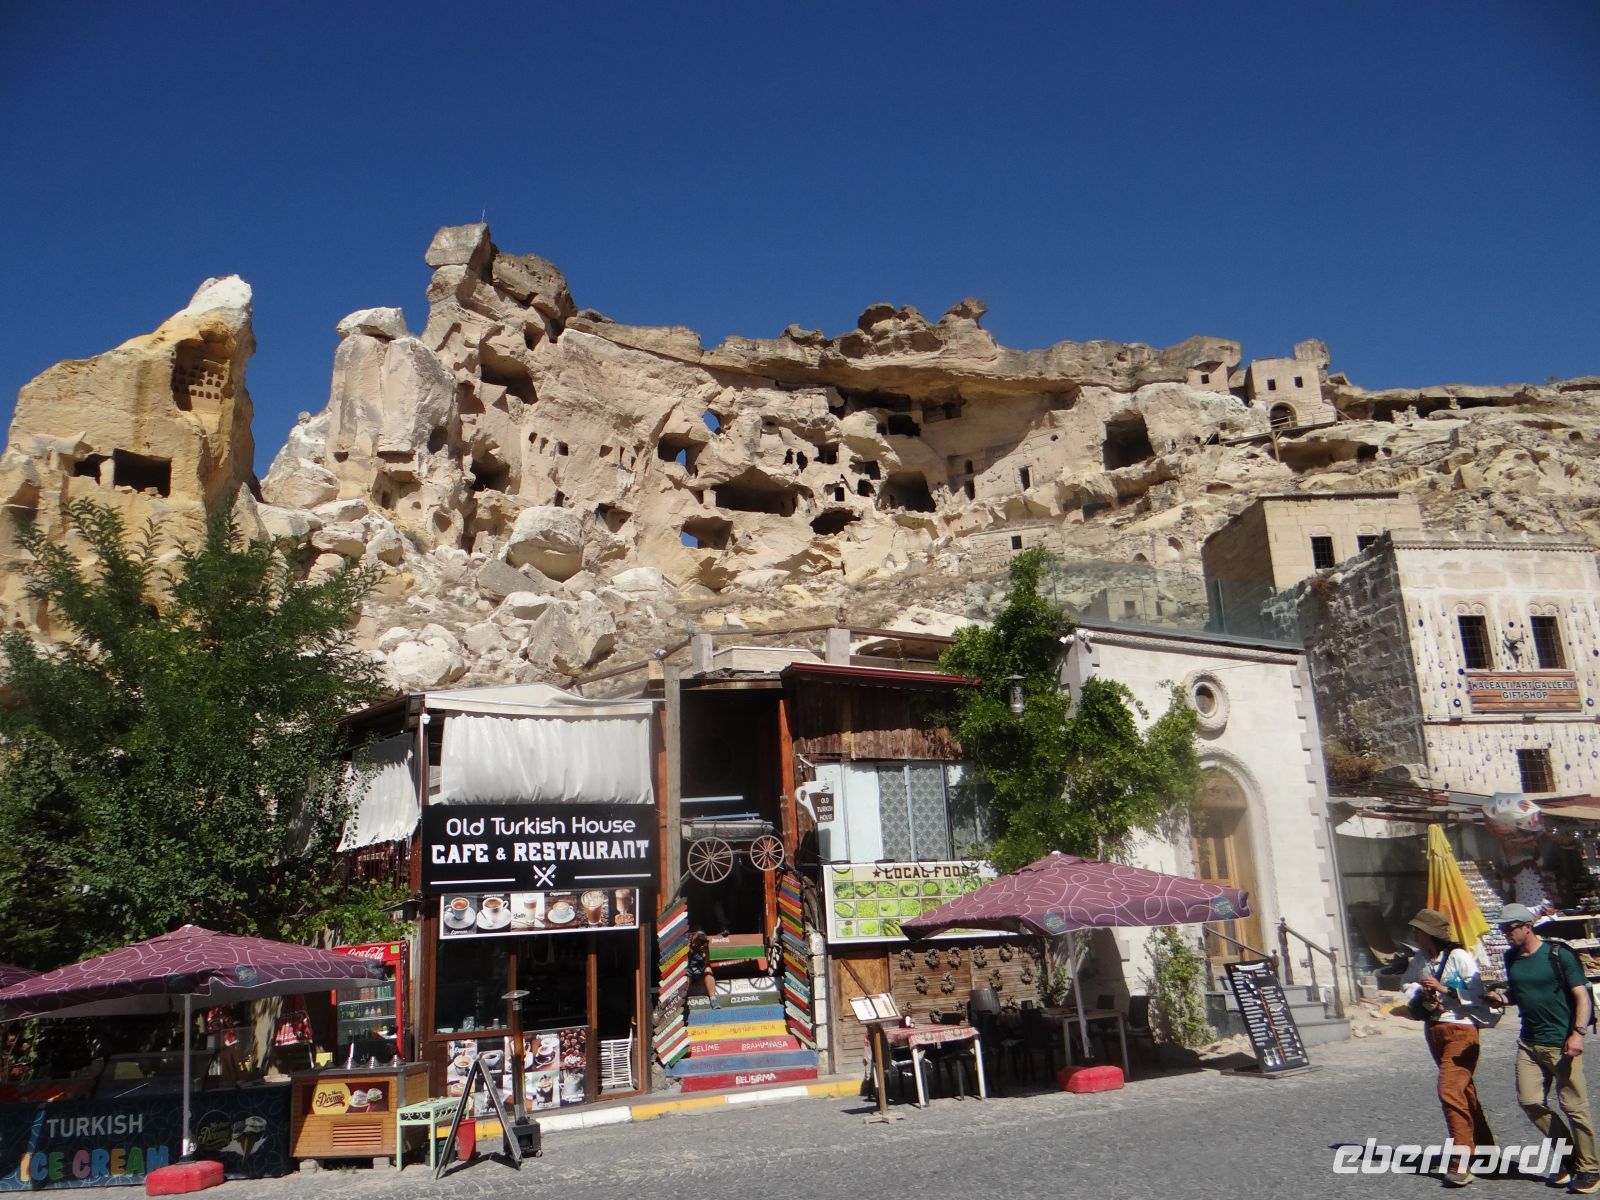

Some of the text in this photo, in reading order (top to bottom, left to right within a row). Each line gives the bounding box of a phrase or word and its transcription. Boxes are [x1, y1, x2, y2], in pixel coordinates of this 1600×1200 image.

[1502, 691, 1548, 699] GIFT SHOP
[1514, 681, 1532, 689] ART
[1534, 681, 1575, 689] GALLERY
[446, 816, 636, 836] Old Turkish House
[431, 840, 650, 864] CAFE & RESTAURANT
[884, 865, 930, 879] LOCAL
[46, 1113, 143, 1138] TURKISH
[20, 1144, 169, 1182] ICE CREAM
